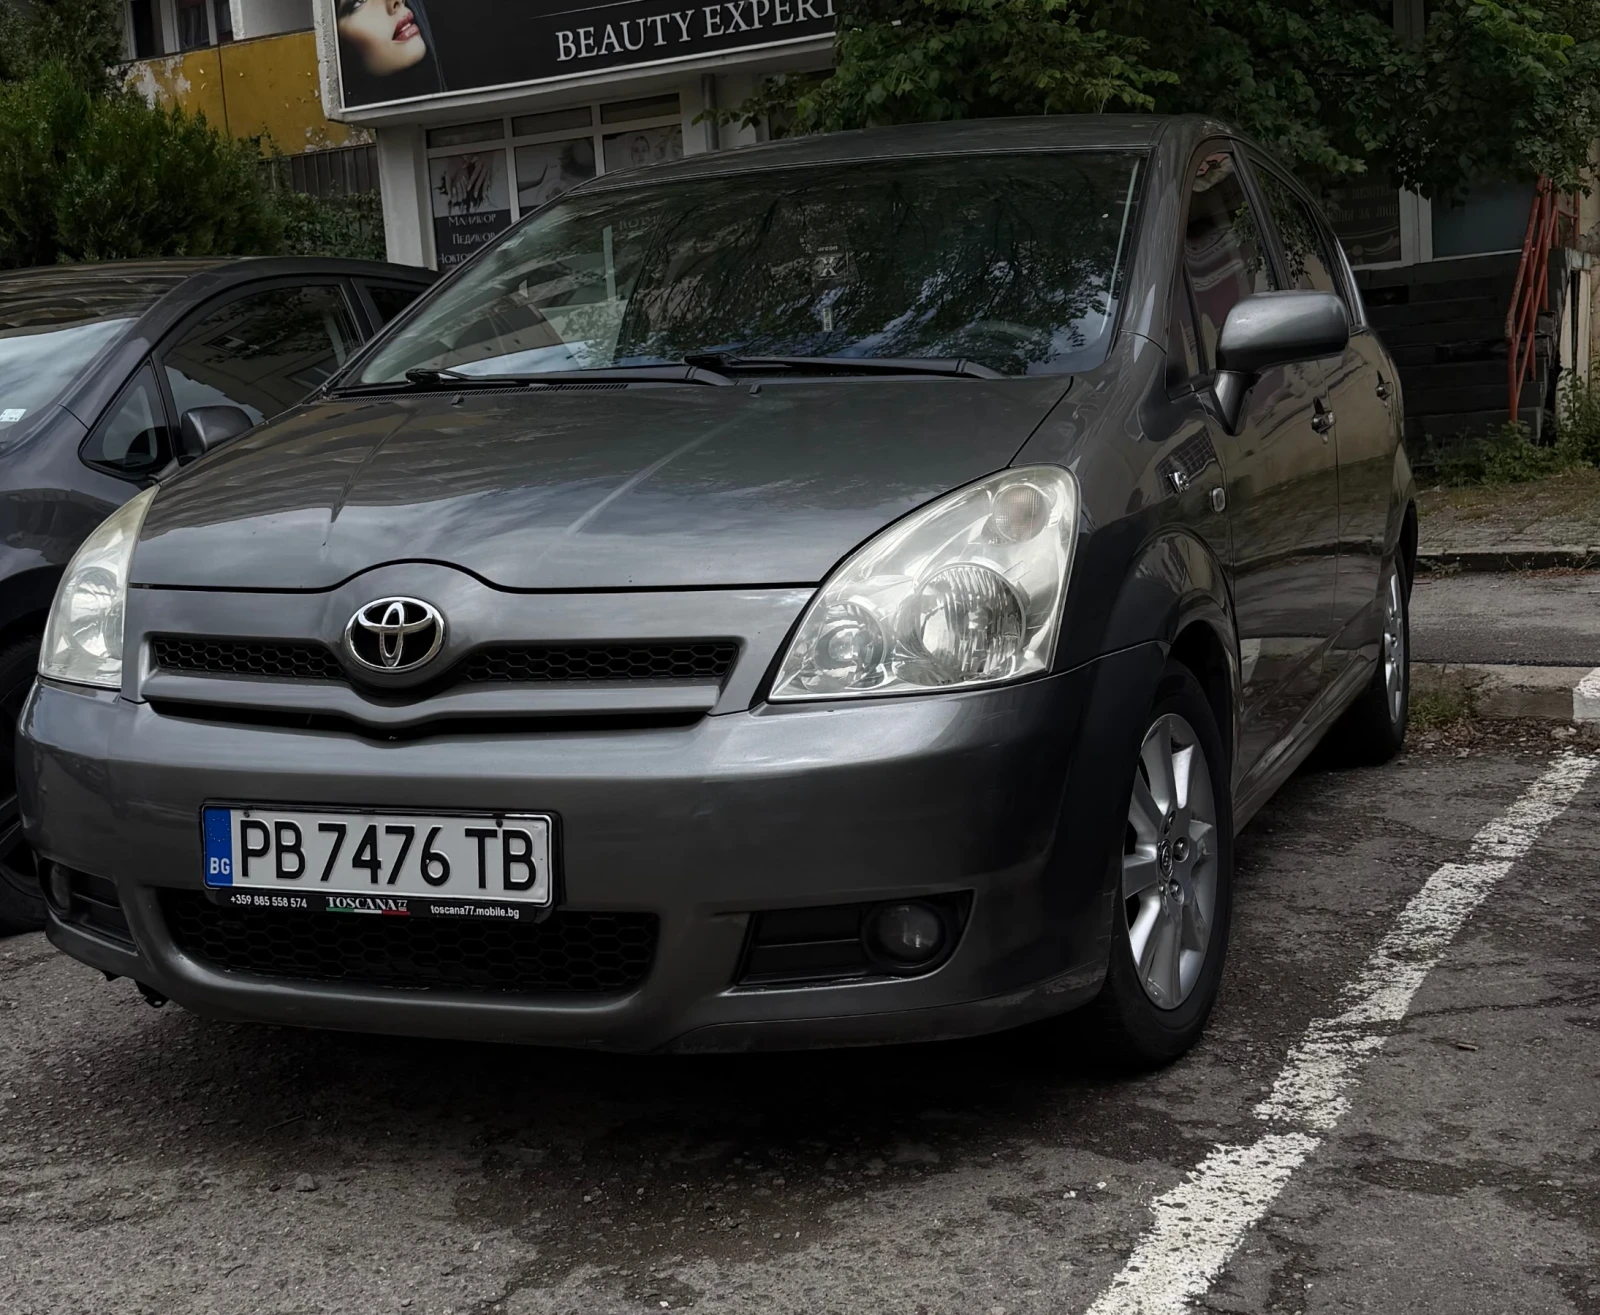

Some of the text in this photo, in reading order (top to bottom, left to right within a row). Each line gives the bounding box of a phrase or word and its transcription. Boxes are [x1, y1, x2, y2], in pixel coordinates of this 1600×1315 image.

[555, 9, 695, 61] BEAUTY
[240, 819, 537, 891] PB 7476 TB
[209, 857, 231, 875] BG
[230, 894, 307, 908] +359 885 558 574
[430, 904, 519, 919] toscana77.mobile.bg
